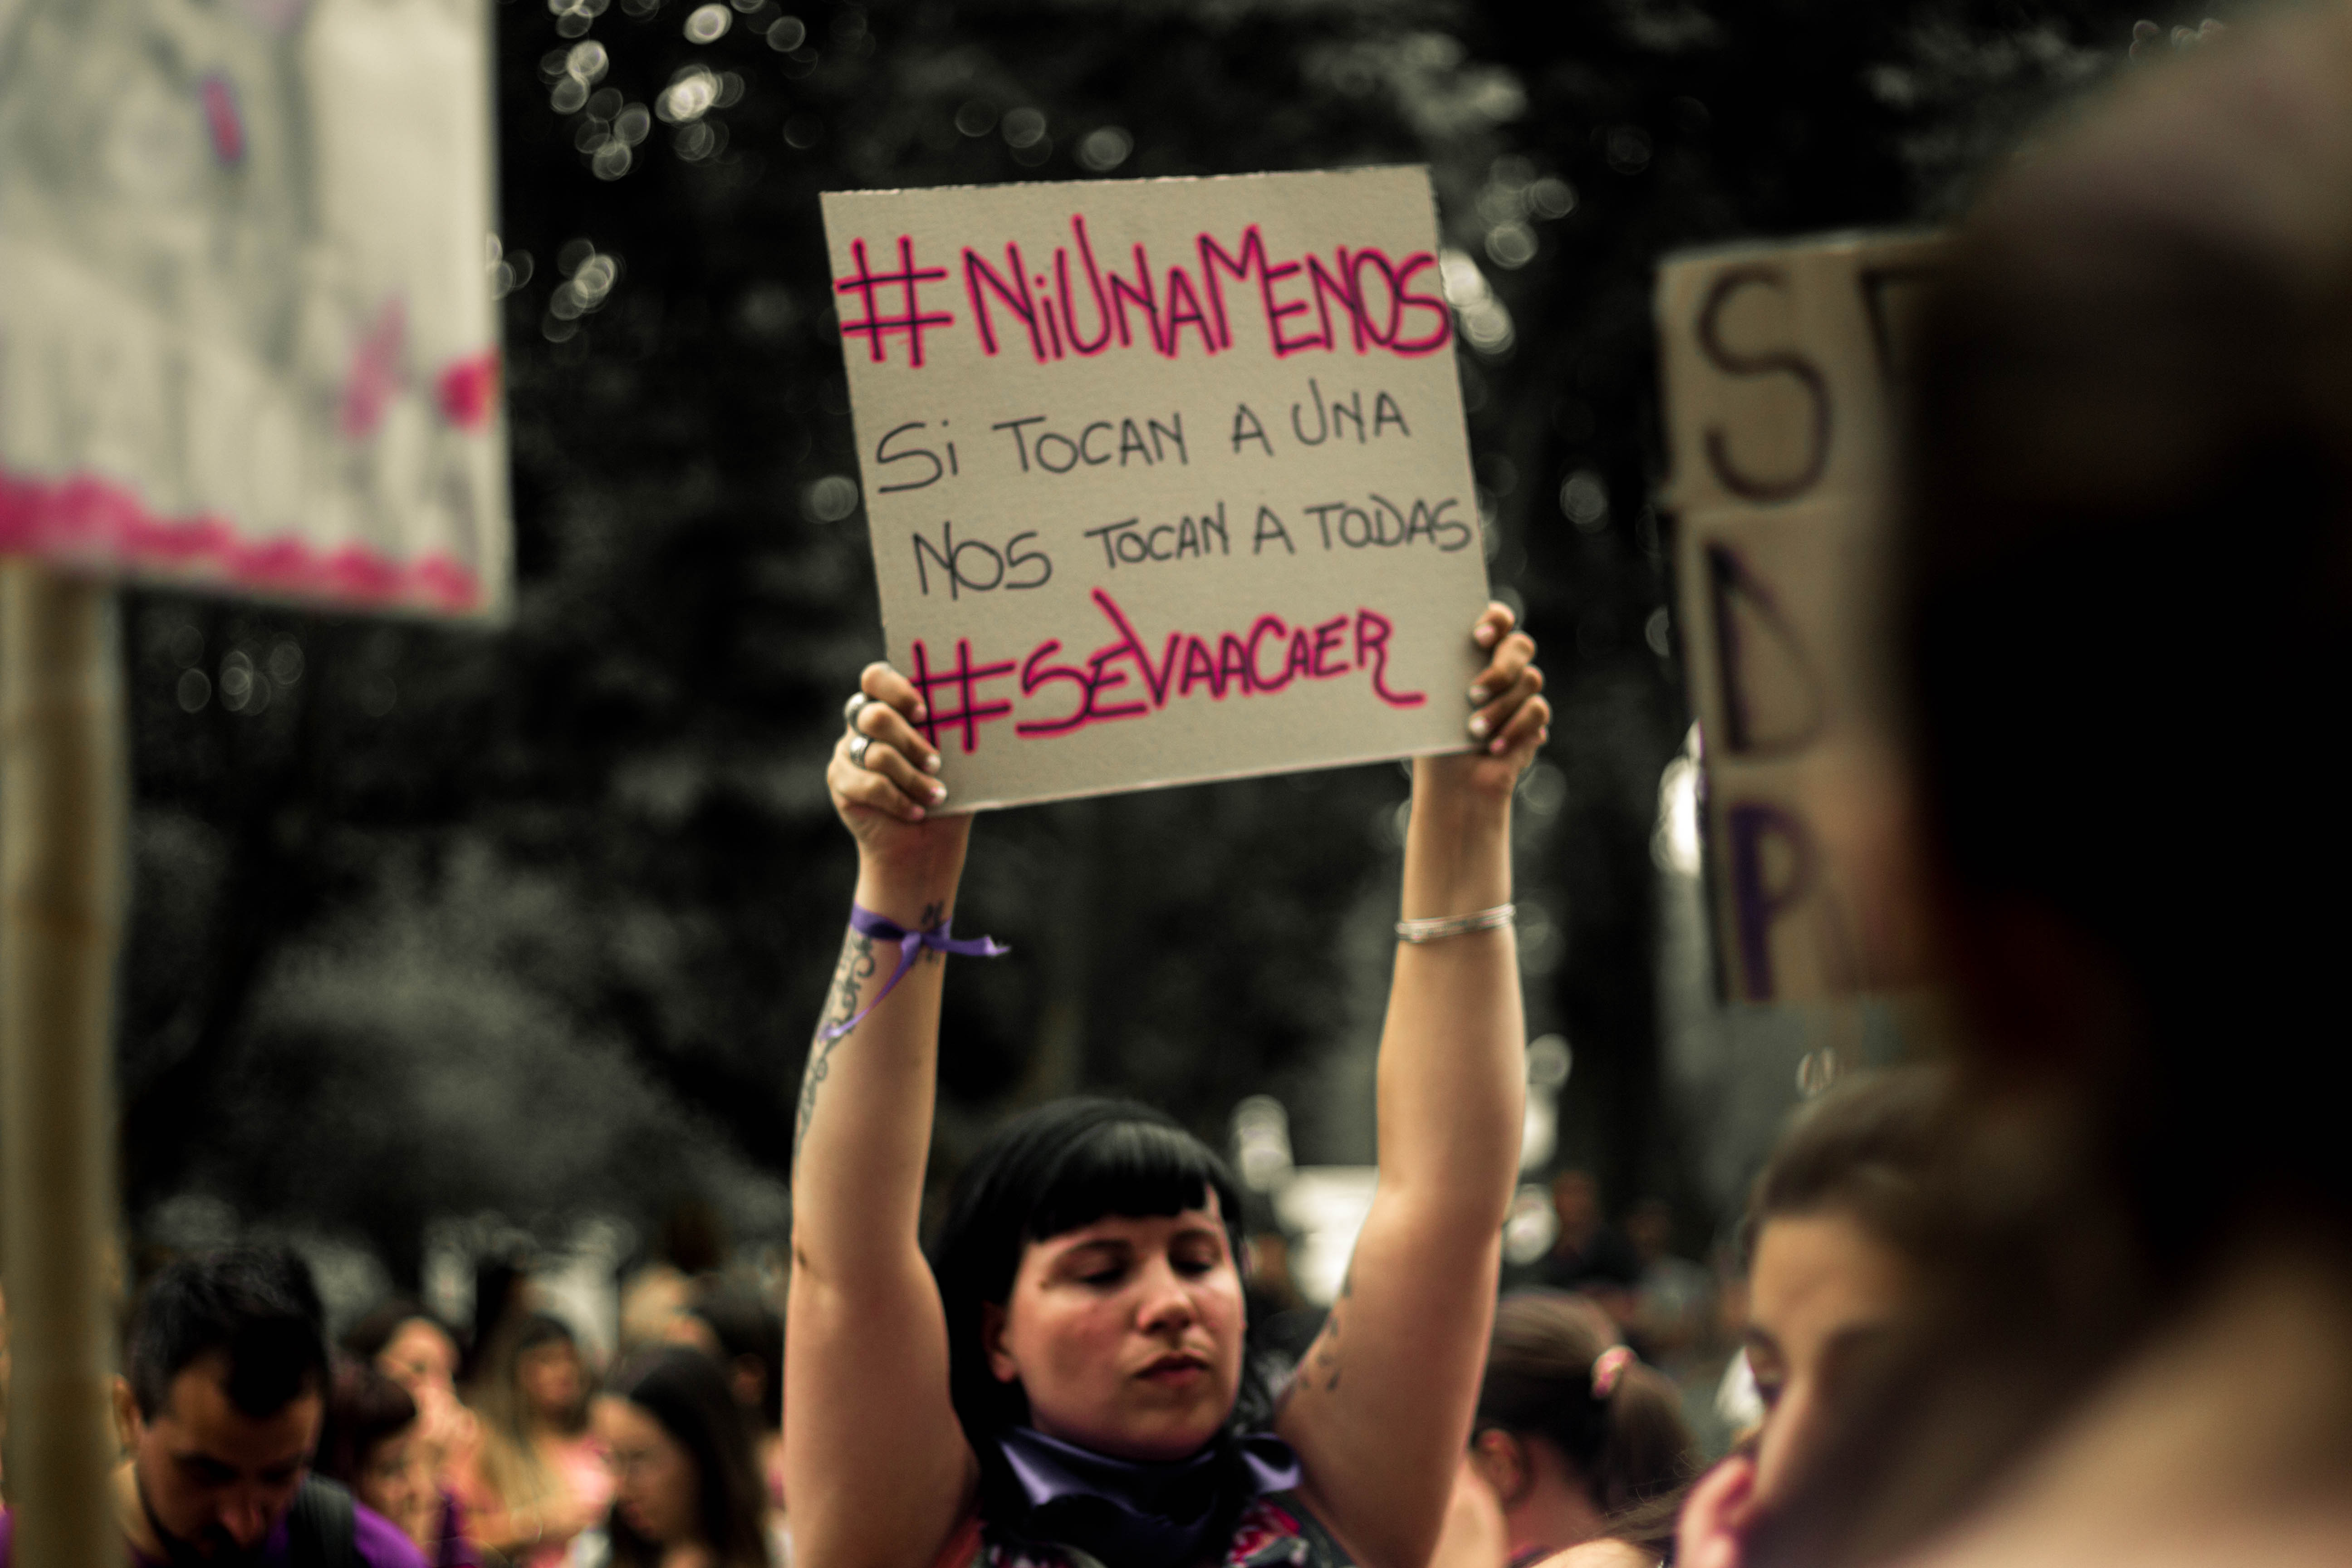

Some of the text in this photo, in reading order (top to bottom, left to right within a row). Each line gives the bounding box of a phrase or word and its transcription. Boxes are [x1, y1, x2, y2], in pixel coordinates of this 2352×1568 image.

[991, 412, 1190, 474] TOCAN
[1230, 402, 1275, 457] A
[1289, 377, 1412, 446] UNA
[911, 492, 1475, 601] NOS TOCAN A TODAS
